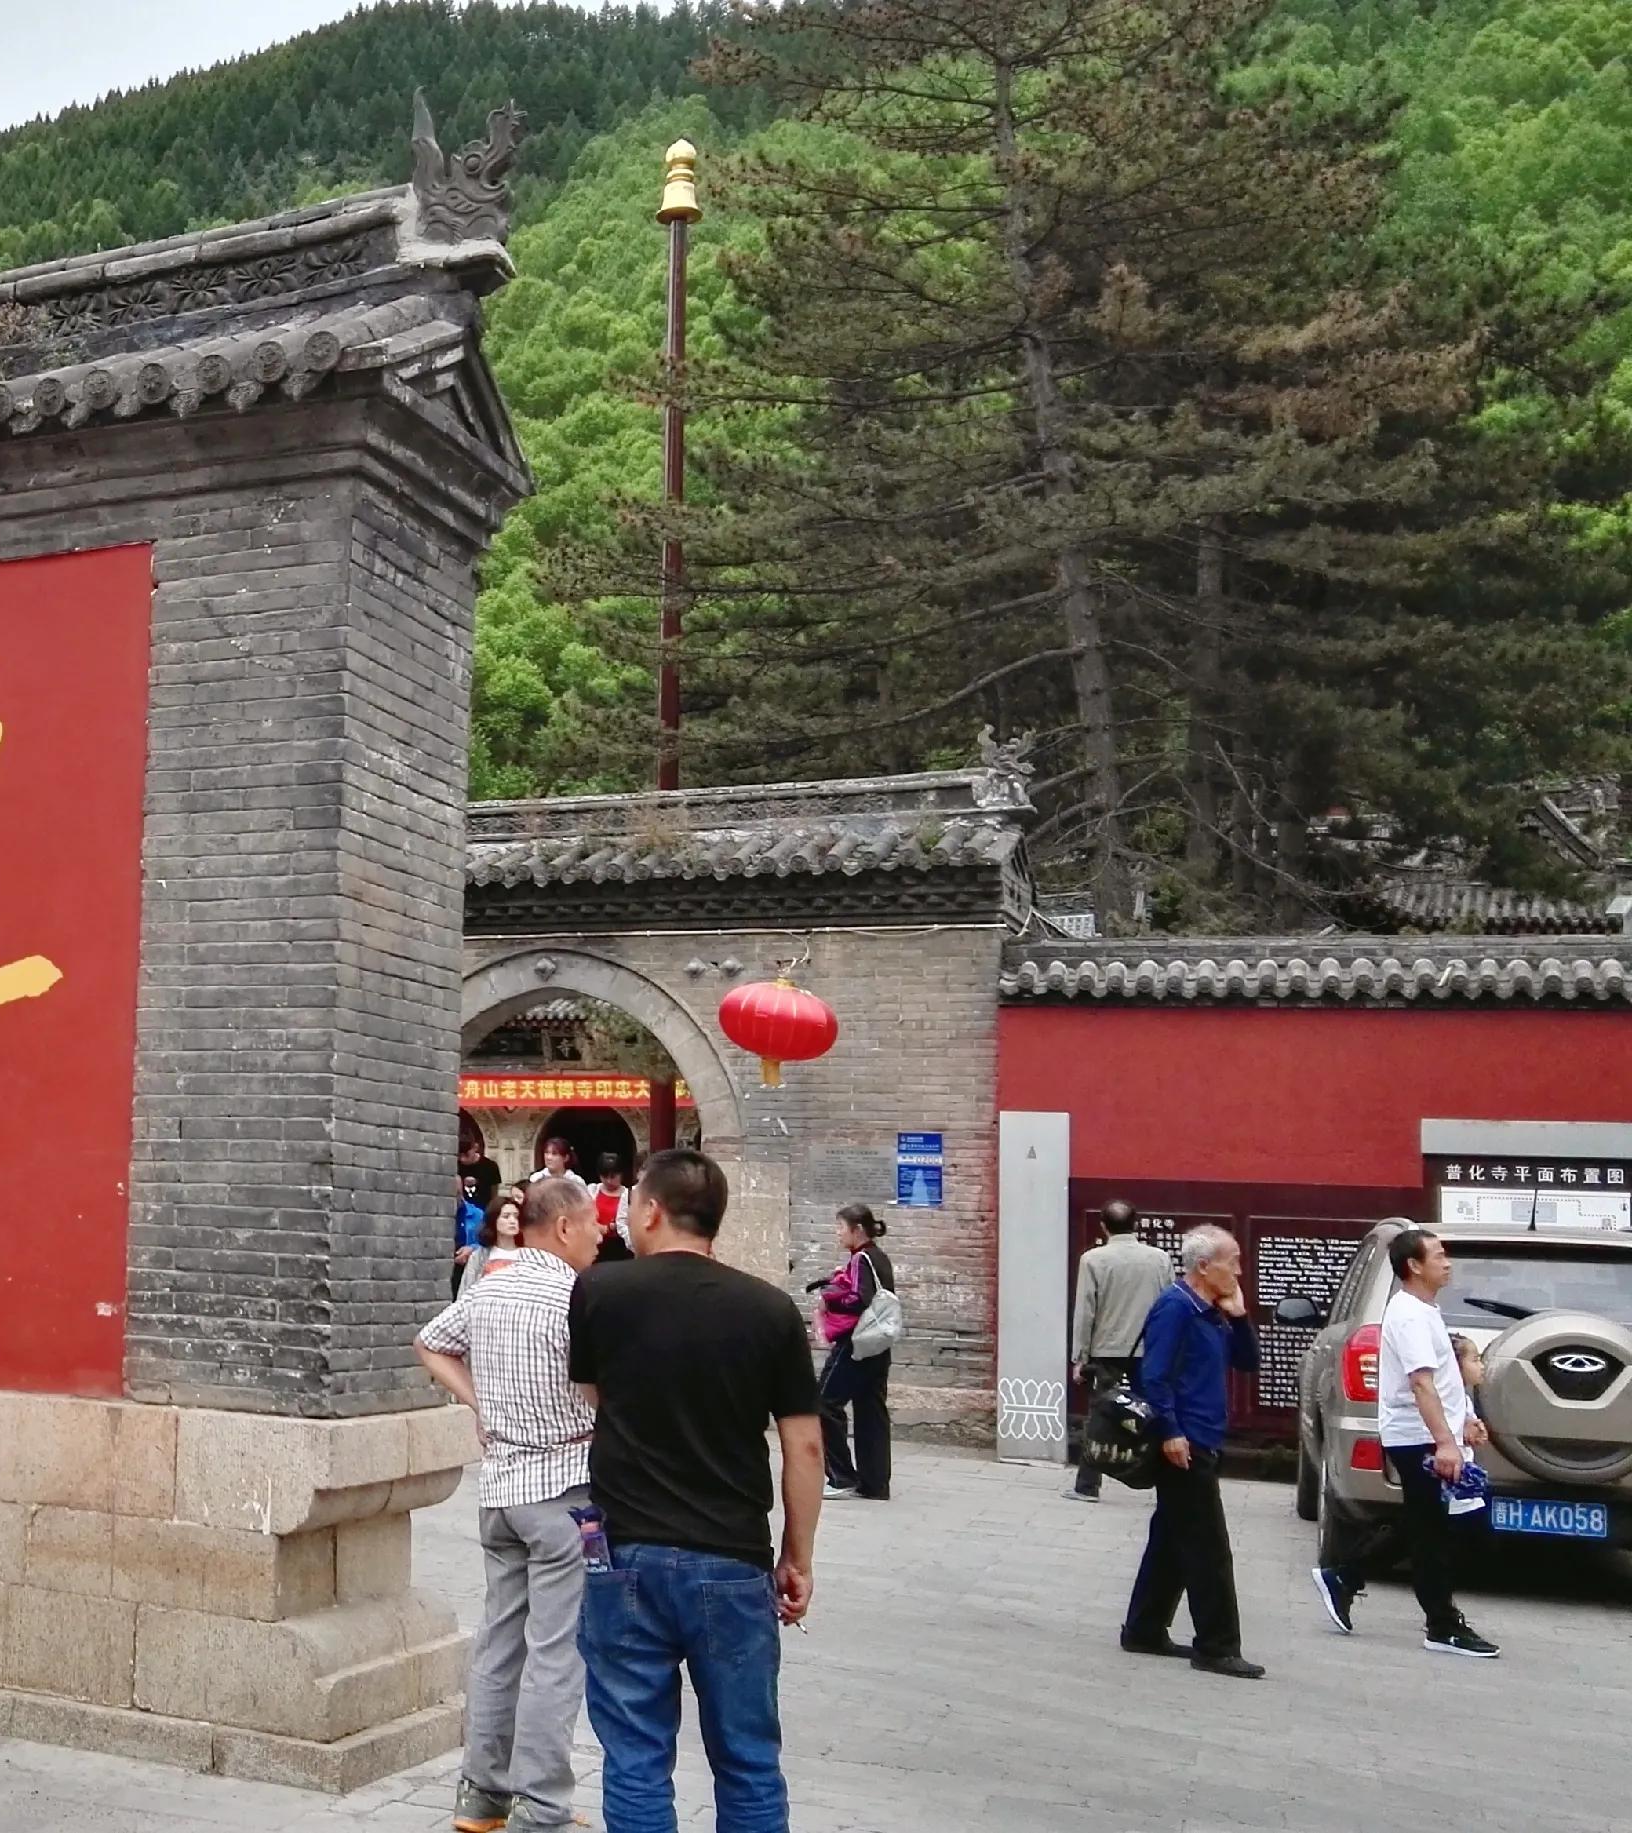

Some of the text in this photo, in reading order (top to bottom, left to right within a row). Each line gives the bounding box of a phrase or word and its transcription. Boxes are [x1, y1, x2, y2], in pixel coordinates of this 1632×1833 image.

[458, 1078, 651, 1099] 舟山老天福禅寺印忠大
[1445, 1163, 1625, 1185] 普化寺平面布置图
